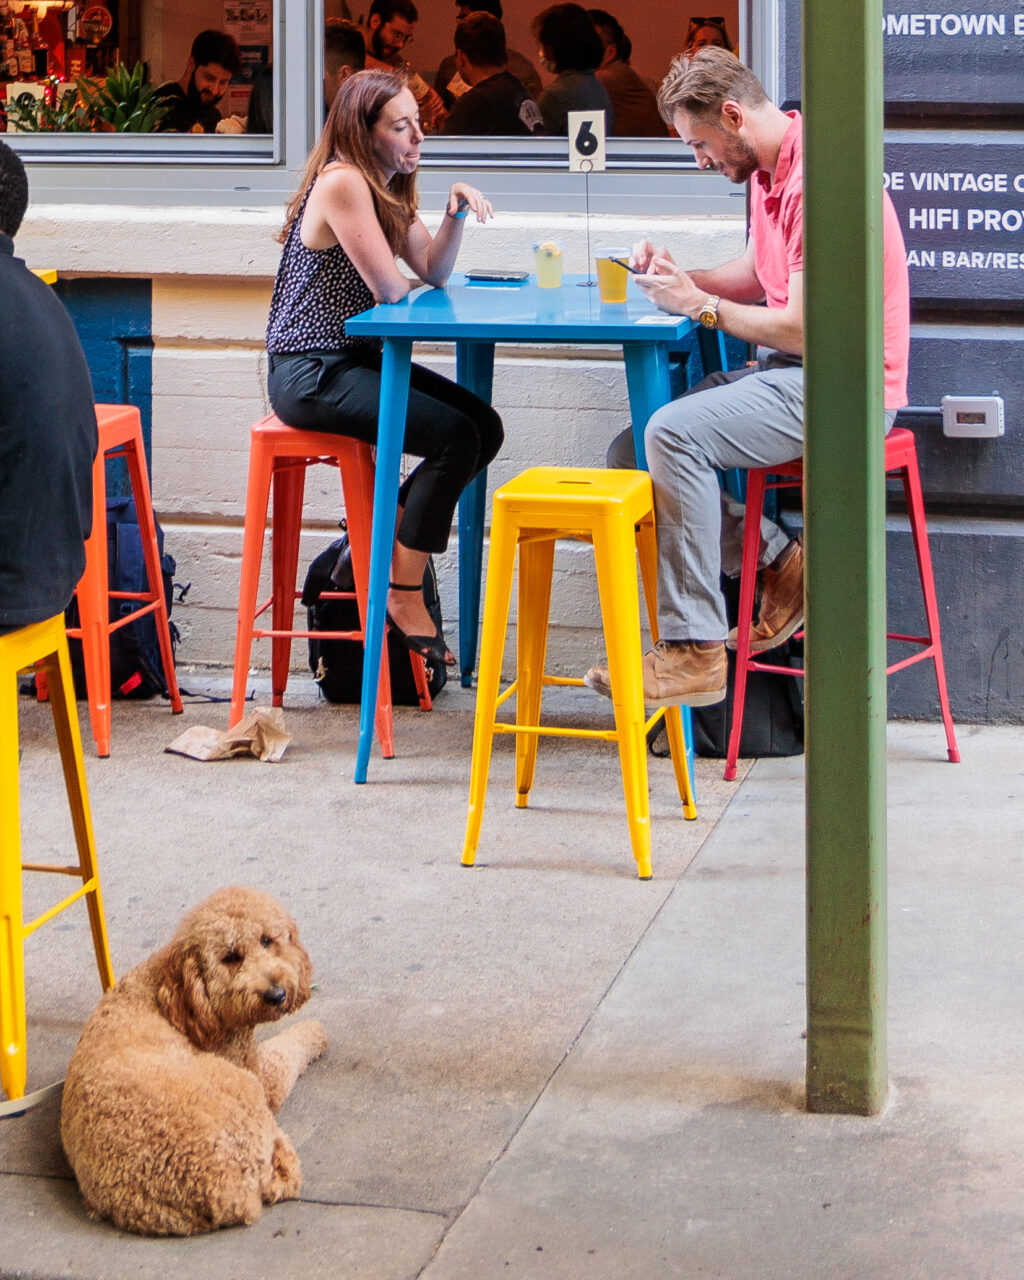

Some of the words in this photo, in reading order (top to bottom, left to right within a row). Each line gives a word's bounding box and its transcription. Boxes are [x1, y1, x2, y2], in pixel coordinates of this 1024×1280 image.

[881, 13, 1006, 36] METOWN
[575, 121, 599, 157] 6
[909, 172, 1008, 193] VINTAGE
[909, 208, 959, 230] HIFI
[967, 208, 1024, 232] PRO
